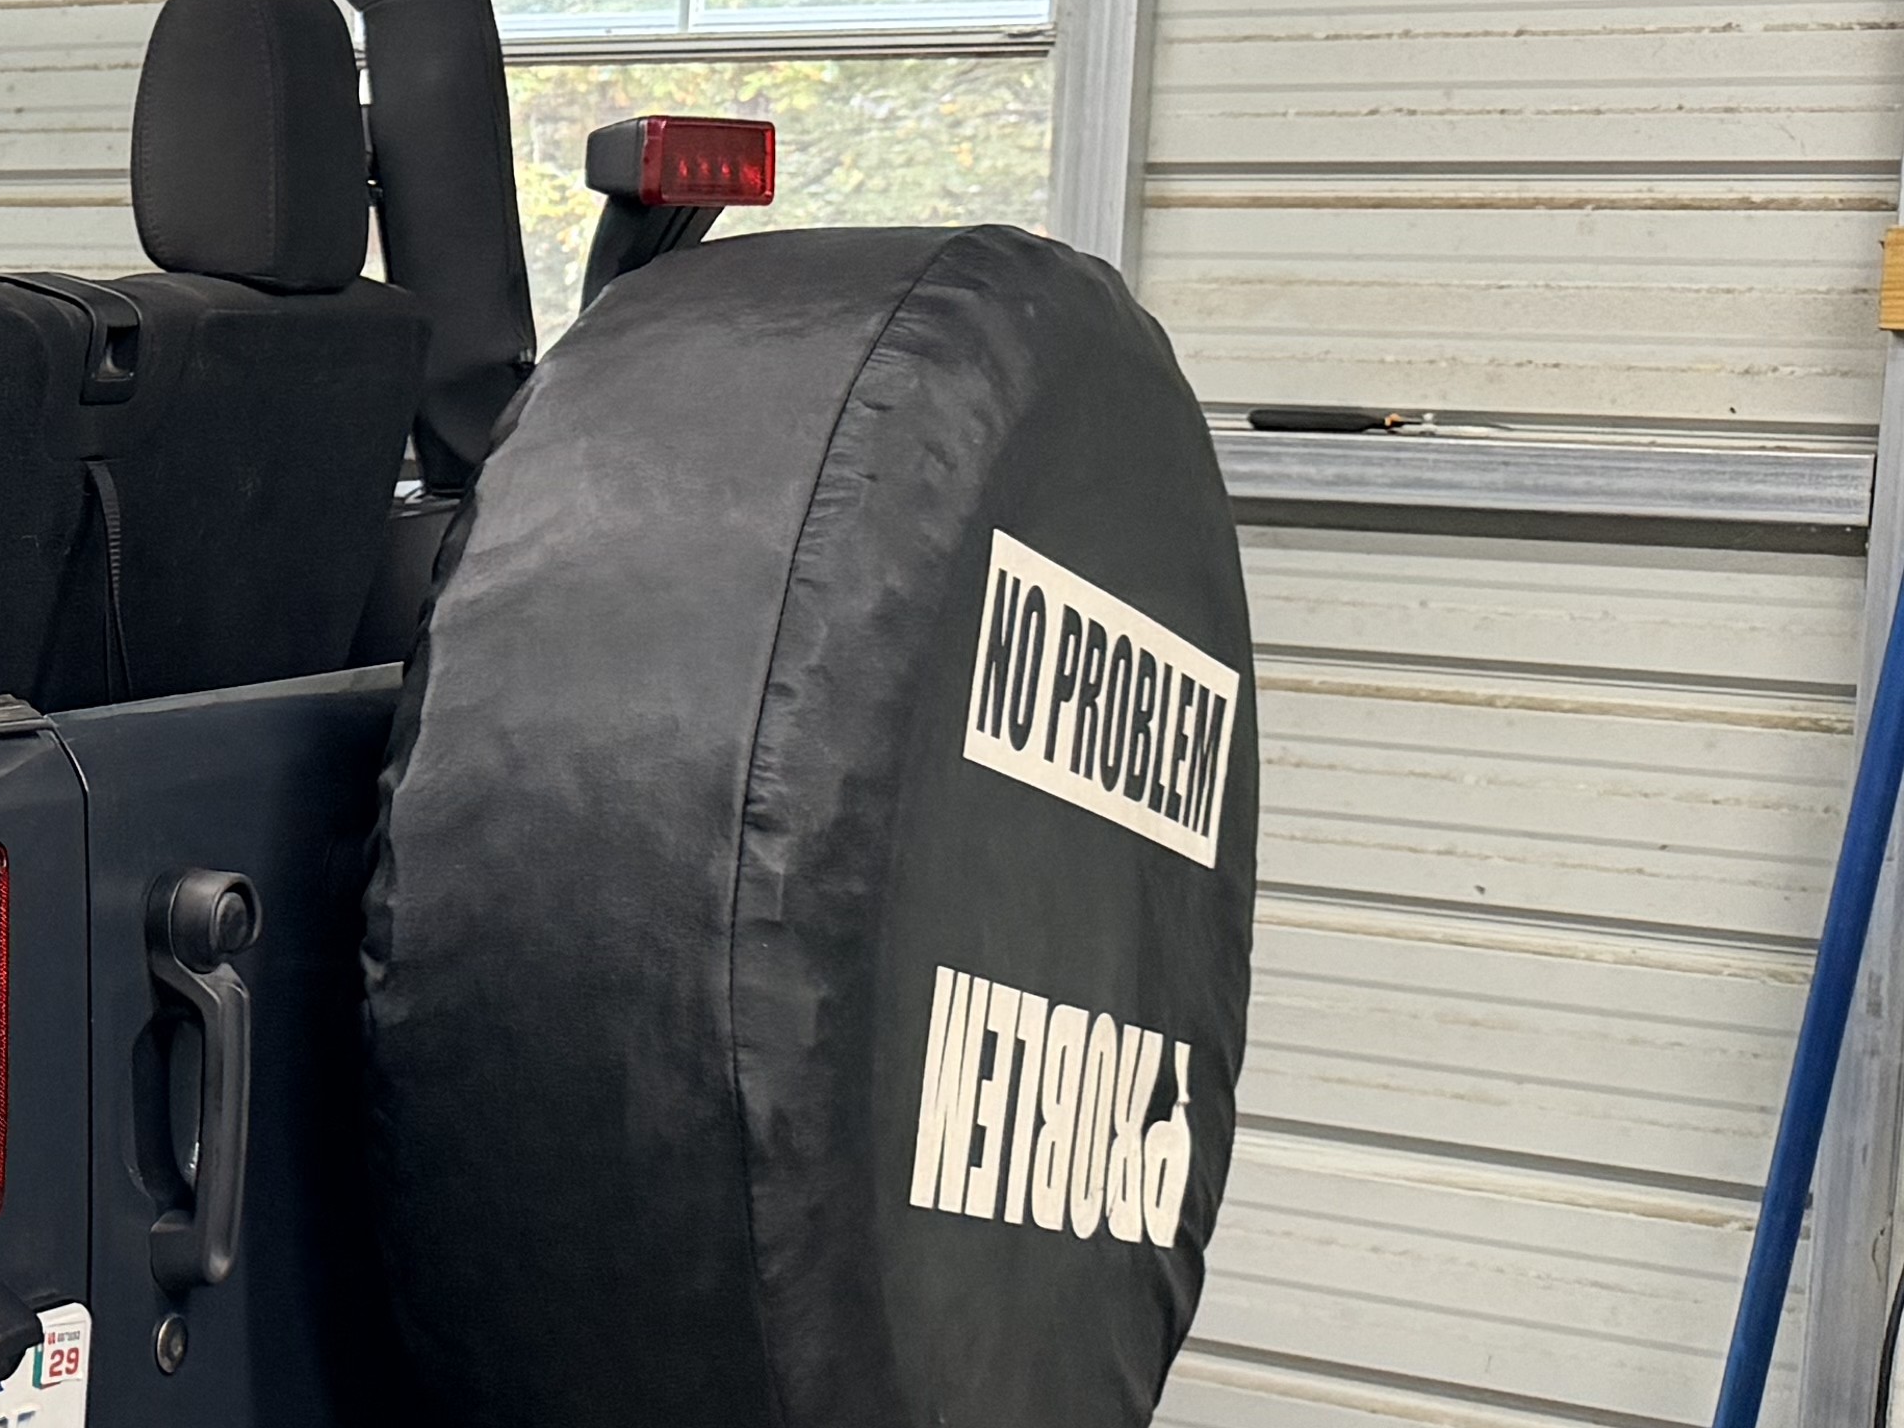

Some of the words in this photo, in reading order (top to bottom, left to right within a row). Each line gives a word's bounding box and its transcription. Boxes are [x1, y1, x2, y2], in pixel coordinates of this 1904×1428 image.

[977, 570, 1046, 751] NO
[1045, 606, 1227, 838] PROBLEM
[910, 966, 1192, 1249] PROBLEM
[49, 1347, 80, 1377] 29
